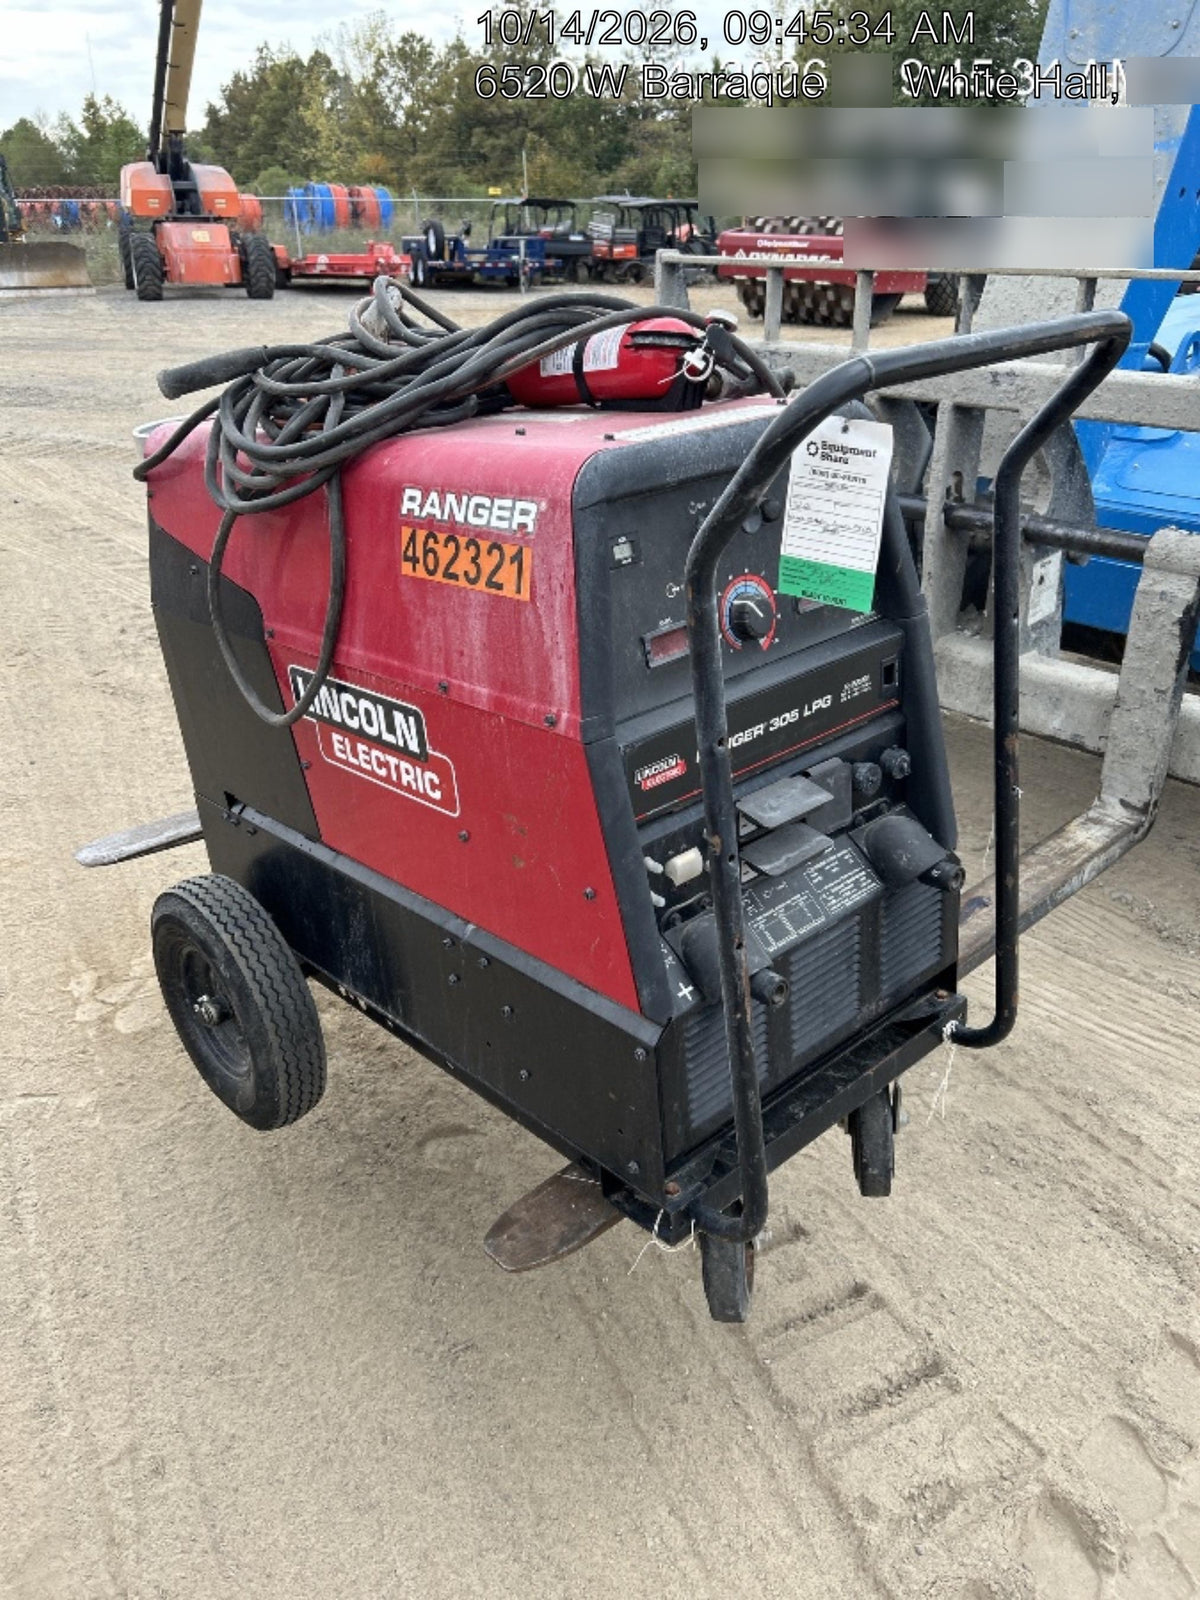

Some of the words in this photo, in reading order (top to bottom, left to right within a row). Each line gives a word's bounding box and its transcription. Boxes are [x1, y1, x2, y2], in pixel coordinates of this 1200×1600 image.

[820, 451, 849, 465] Share
[400, 487, 538, 533] RANGER
[403, 529, 524, 595] 462321
[296, 676, 420, 755] LINCOLN
[769, 708, 799, 731] 305
[803, 695, 832, 717] LPG
[332, 732, 442, 800] ELECTRIC
